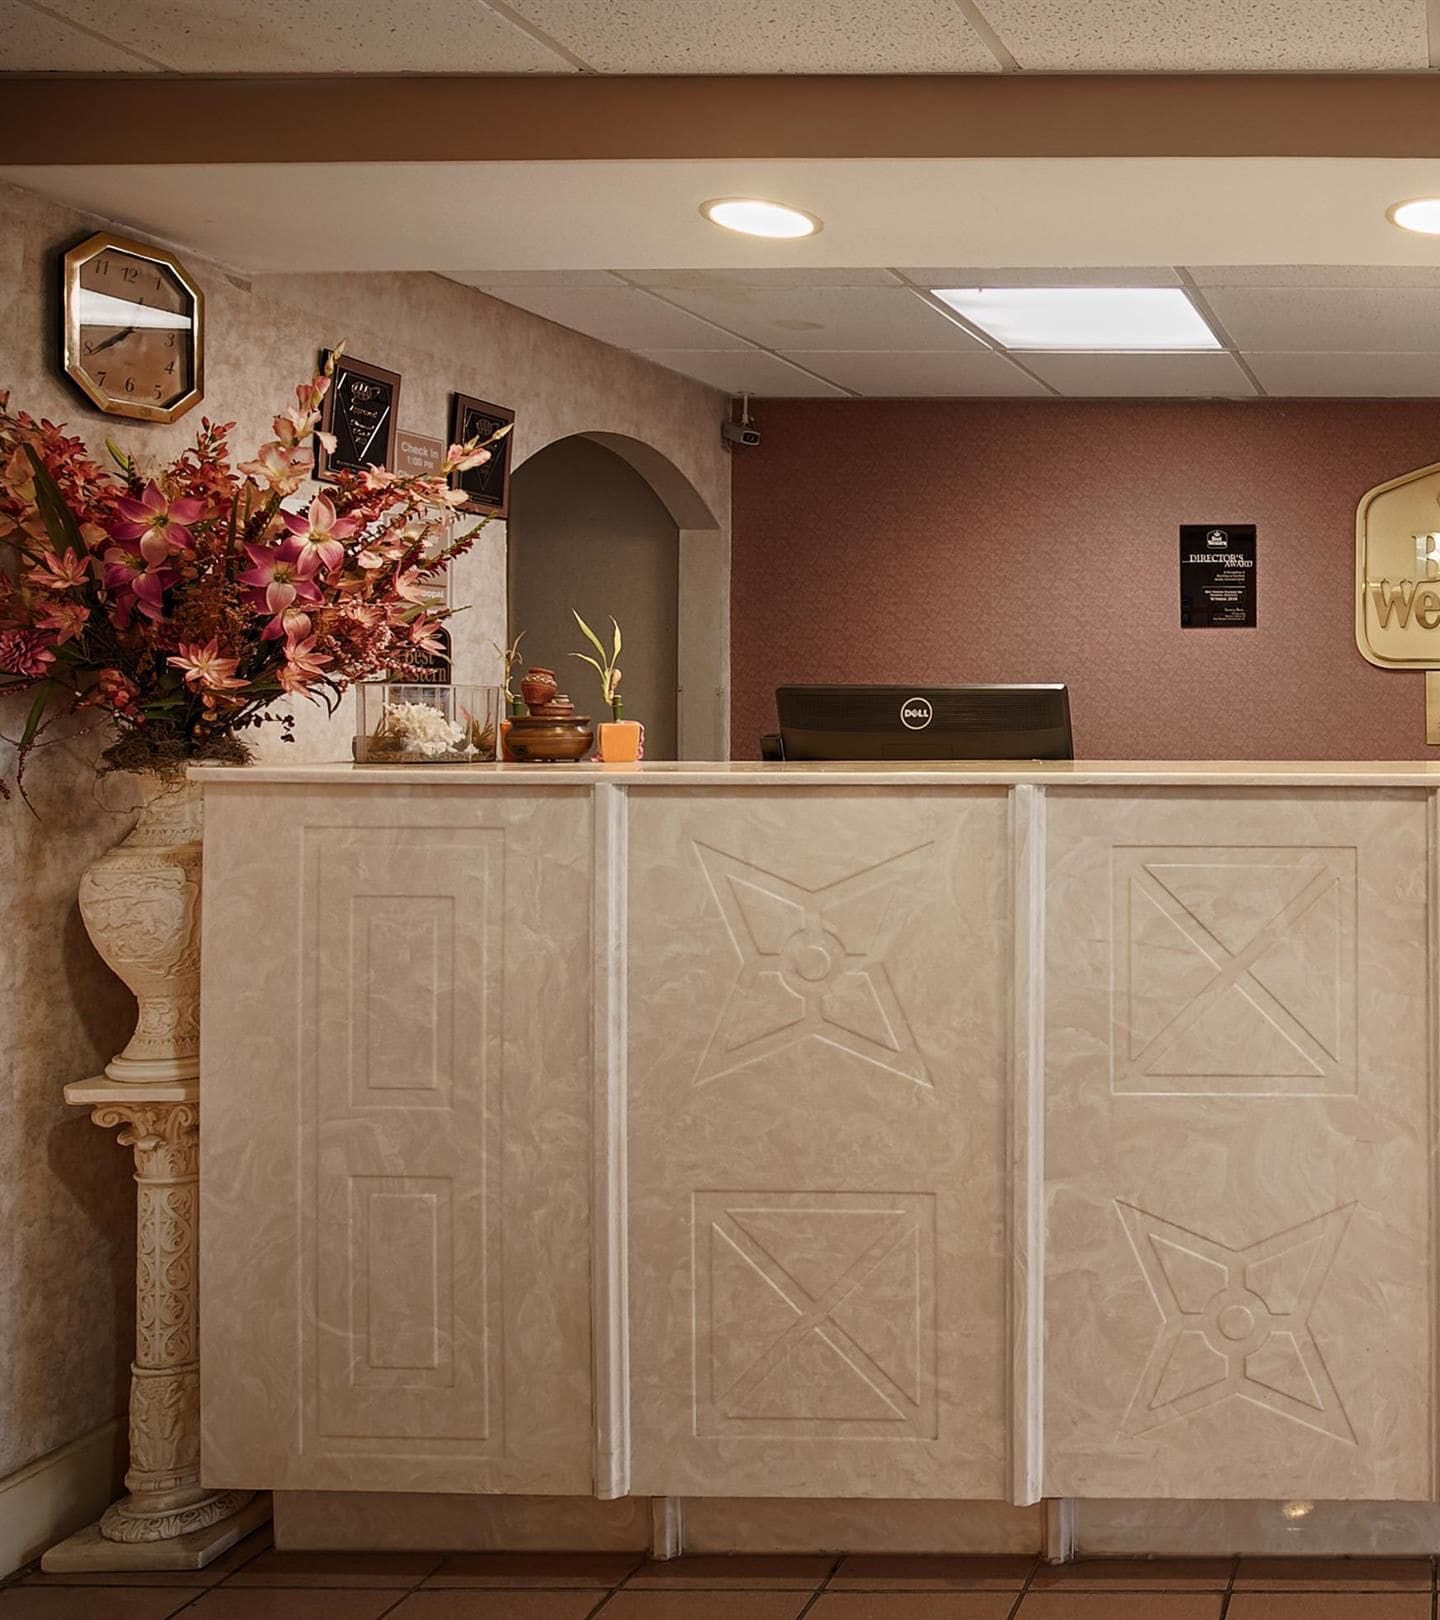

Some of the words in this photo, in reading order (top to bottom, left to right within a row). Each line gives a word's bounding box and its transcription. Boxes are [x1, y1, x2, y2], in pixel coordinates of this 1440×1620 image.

[95, 259, 109, 275] 11
[121, 266, 138, 283] 12
[154, 276, 161, 290] 1
[164, 333, 175, 347] 3
[164, 361, 175, 375] 4
[97, 371, 107, 387] 7
[125, 376, 135, 392] 6
[153, 385, 162, 400] 5
[401, 441, 428, 457] Check
[1189, 554, 1244, 563] DIRECTOR'S
[1224, 560, 1253, 568] AWARD
[904, 709, 929, 718] DELL
